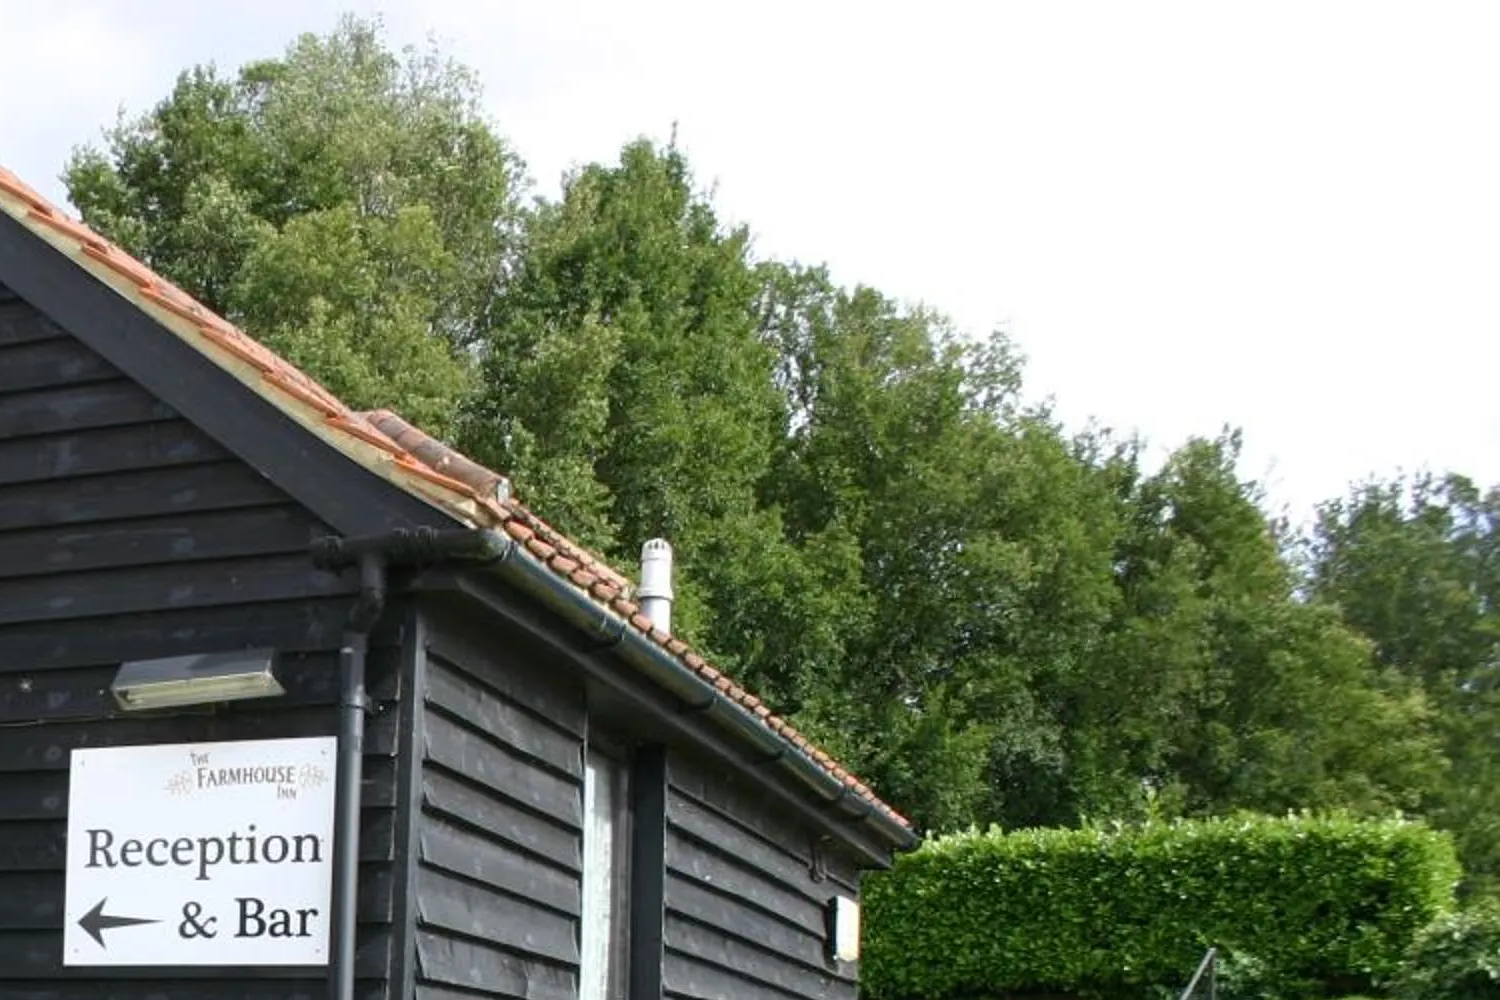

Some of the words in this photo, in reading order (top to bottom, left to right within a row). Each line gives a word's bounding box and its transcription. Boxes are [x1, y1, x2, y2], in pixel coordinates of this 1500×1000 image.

[190, 752, 211, 767] THE
[197, 765, 296, 788] FARMHOUSE
[276, 785, 297, 800] INN
[84, 825, 323, 881] Reception
[178, 901, 217, 939] &
[234, 897, 319, 938] Bar
